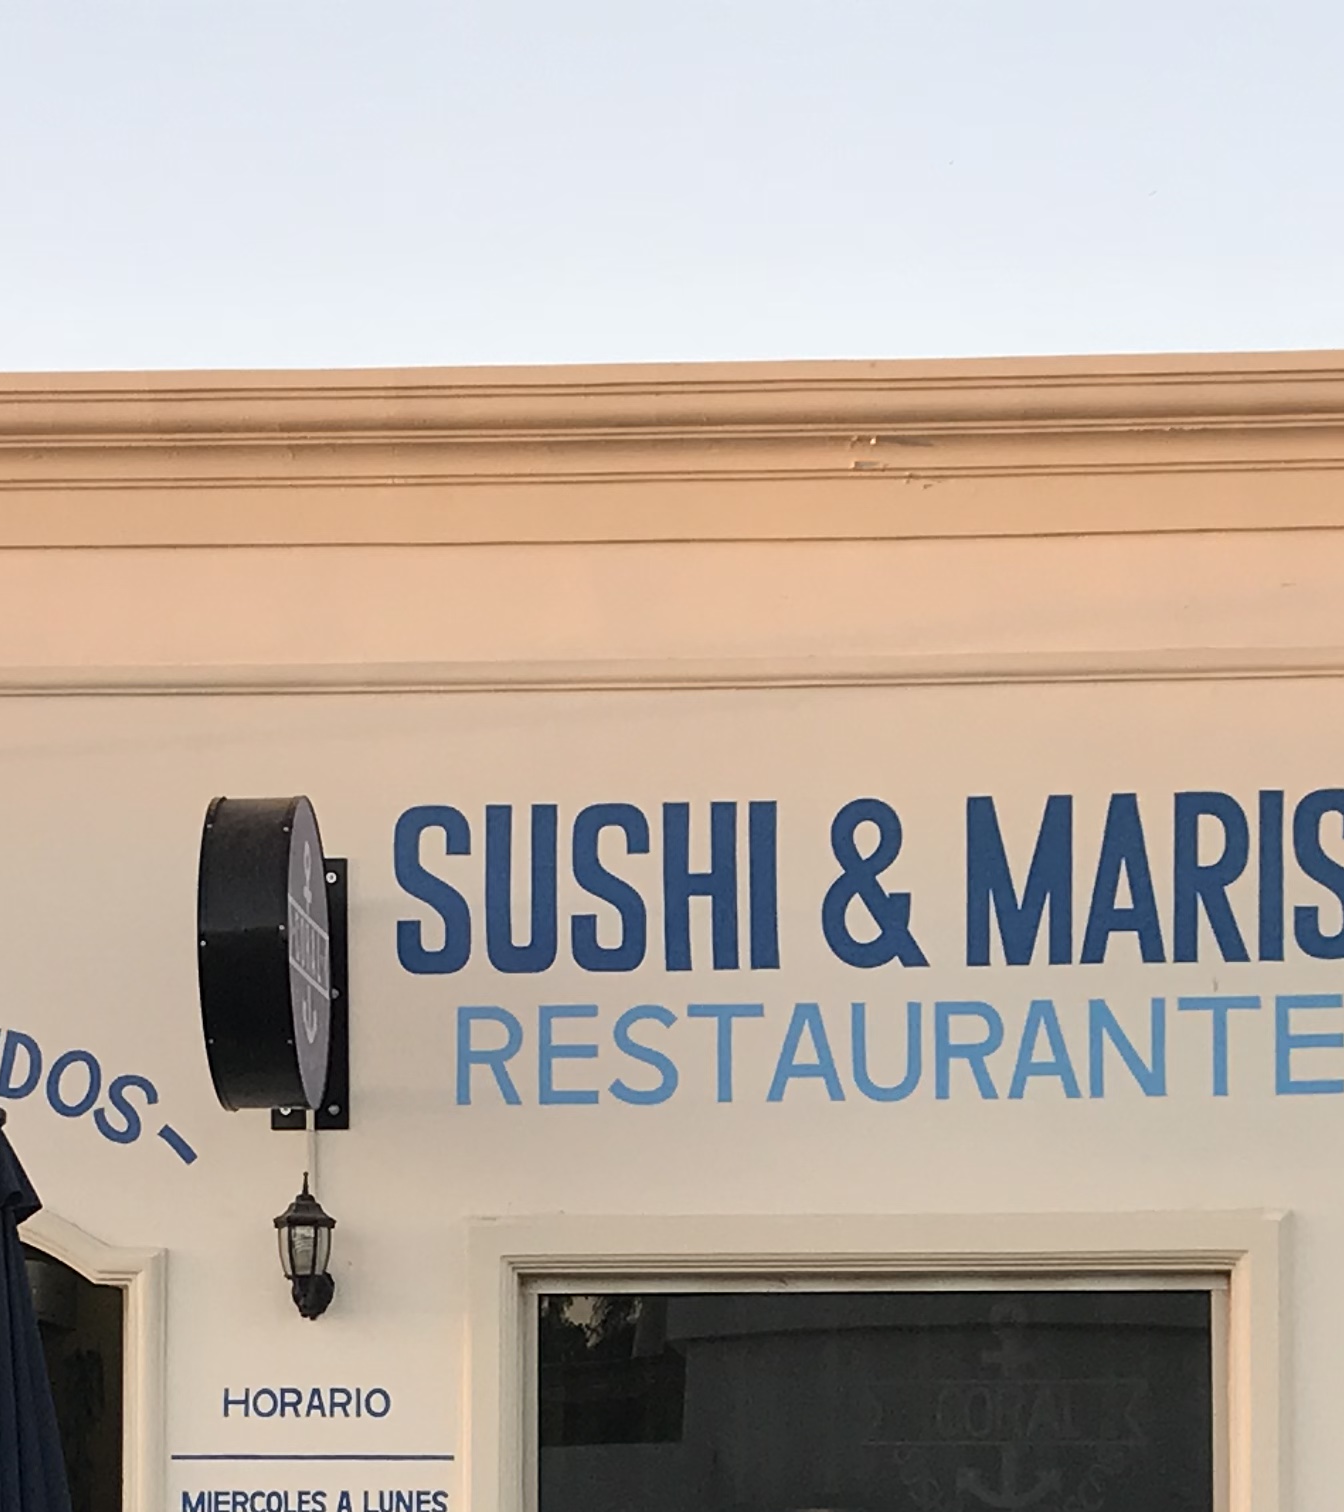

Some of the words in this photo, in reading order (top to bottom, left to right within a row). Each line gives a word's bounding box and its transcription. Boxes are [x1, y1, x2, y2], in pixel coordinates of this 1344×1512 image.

[393, 801, 780, 975] SUSHI
[821, 798, 931, 969] &
[223, 1387, 391, 1418] HORARIO
